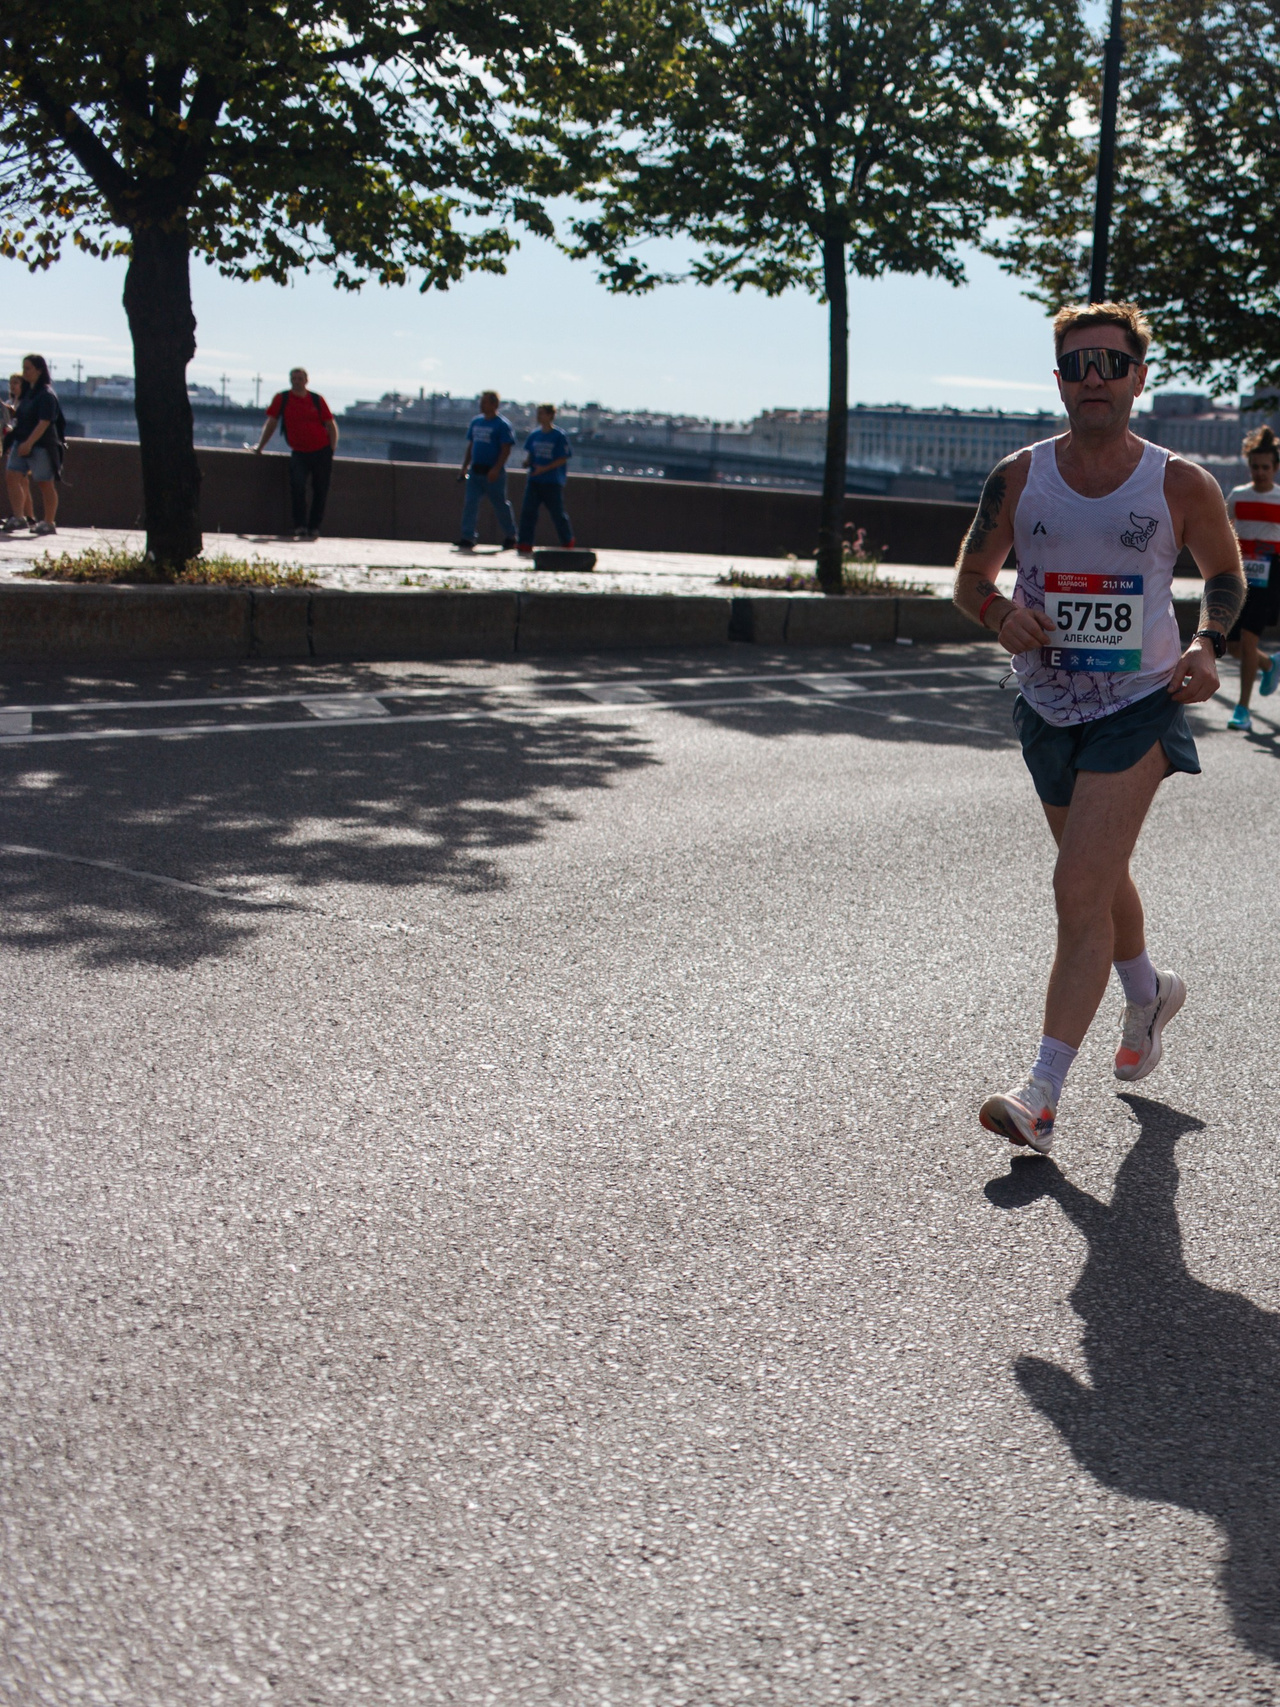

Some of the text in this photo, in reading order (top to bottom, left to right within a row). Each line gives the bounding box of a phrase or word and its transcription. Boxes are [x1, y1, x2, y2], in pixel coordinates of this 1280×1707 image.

[1124, 520, 1155, 545] ПЕТЕРГОФ
[1057, 580, 1088, 588] МАРАФОН
[1102, 580, 1118, 590] 21,1
[1057, 600, 1132, 633] 5758
[1063, 633, 1123, 645] АЛЕКСАНДР
[1050, 649, 1062, 667] E
